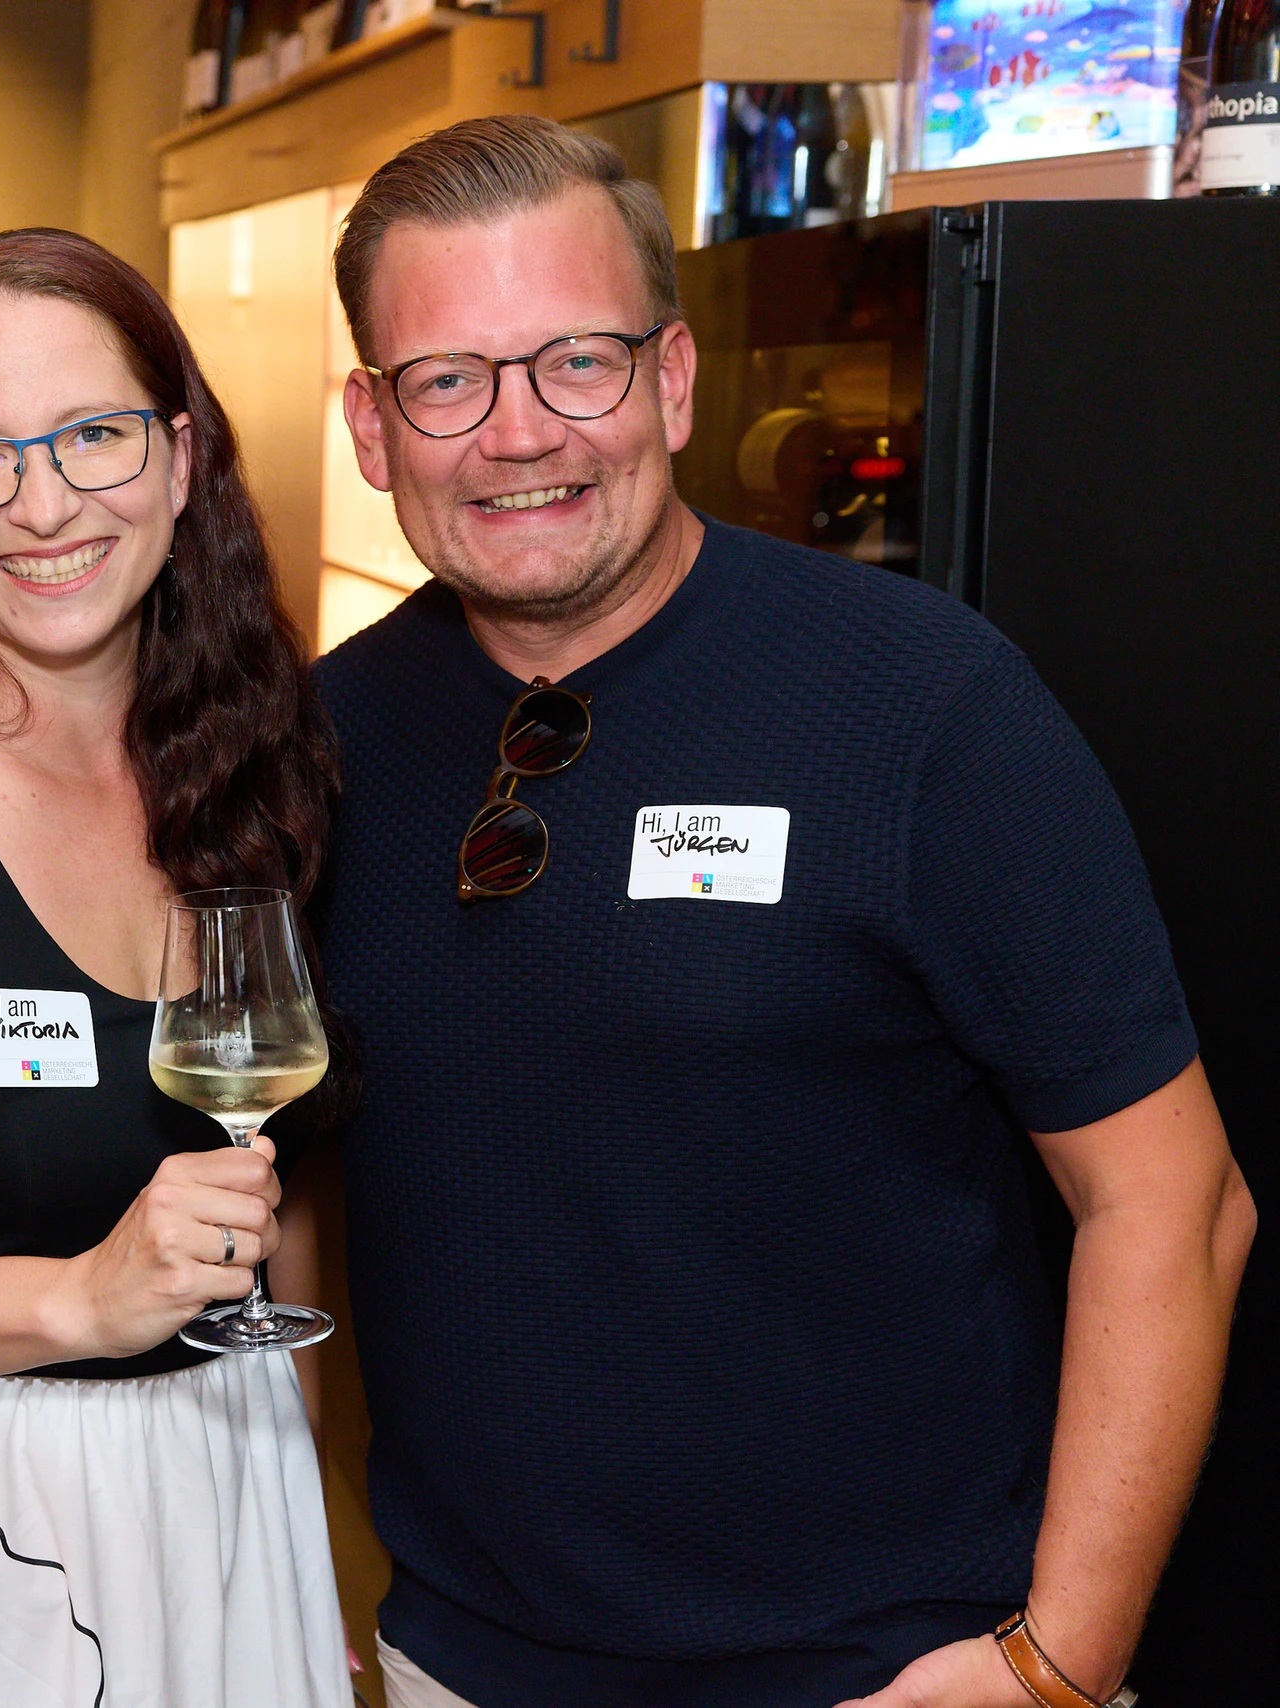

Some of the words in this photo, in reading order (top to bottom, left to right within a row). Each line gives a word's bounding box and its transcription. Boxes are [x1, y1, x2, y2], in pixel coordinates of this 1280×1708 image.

[642, 812, 666, 836] Hi,
[675, 811, 680, 832] I
[687, 815, 721, 832] am
[650, 830, 749, 858] JÜRGEN
[715, 888, 765, 898] GESELLSCHAFT
[716, 881, 755, 891] MARKETING
[8, 999, 37, 1017] am
[43, 1073, 86, 1081] GESELLSCHAFT
